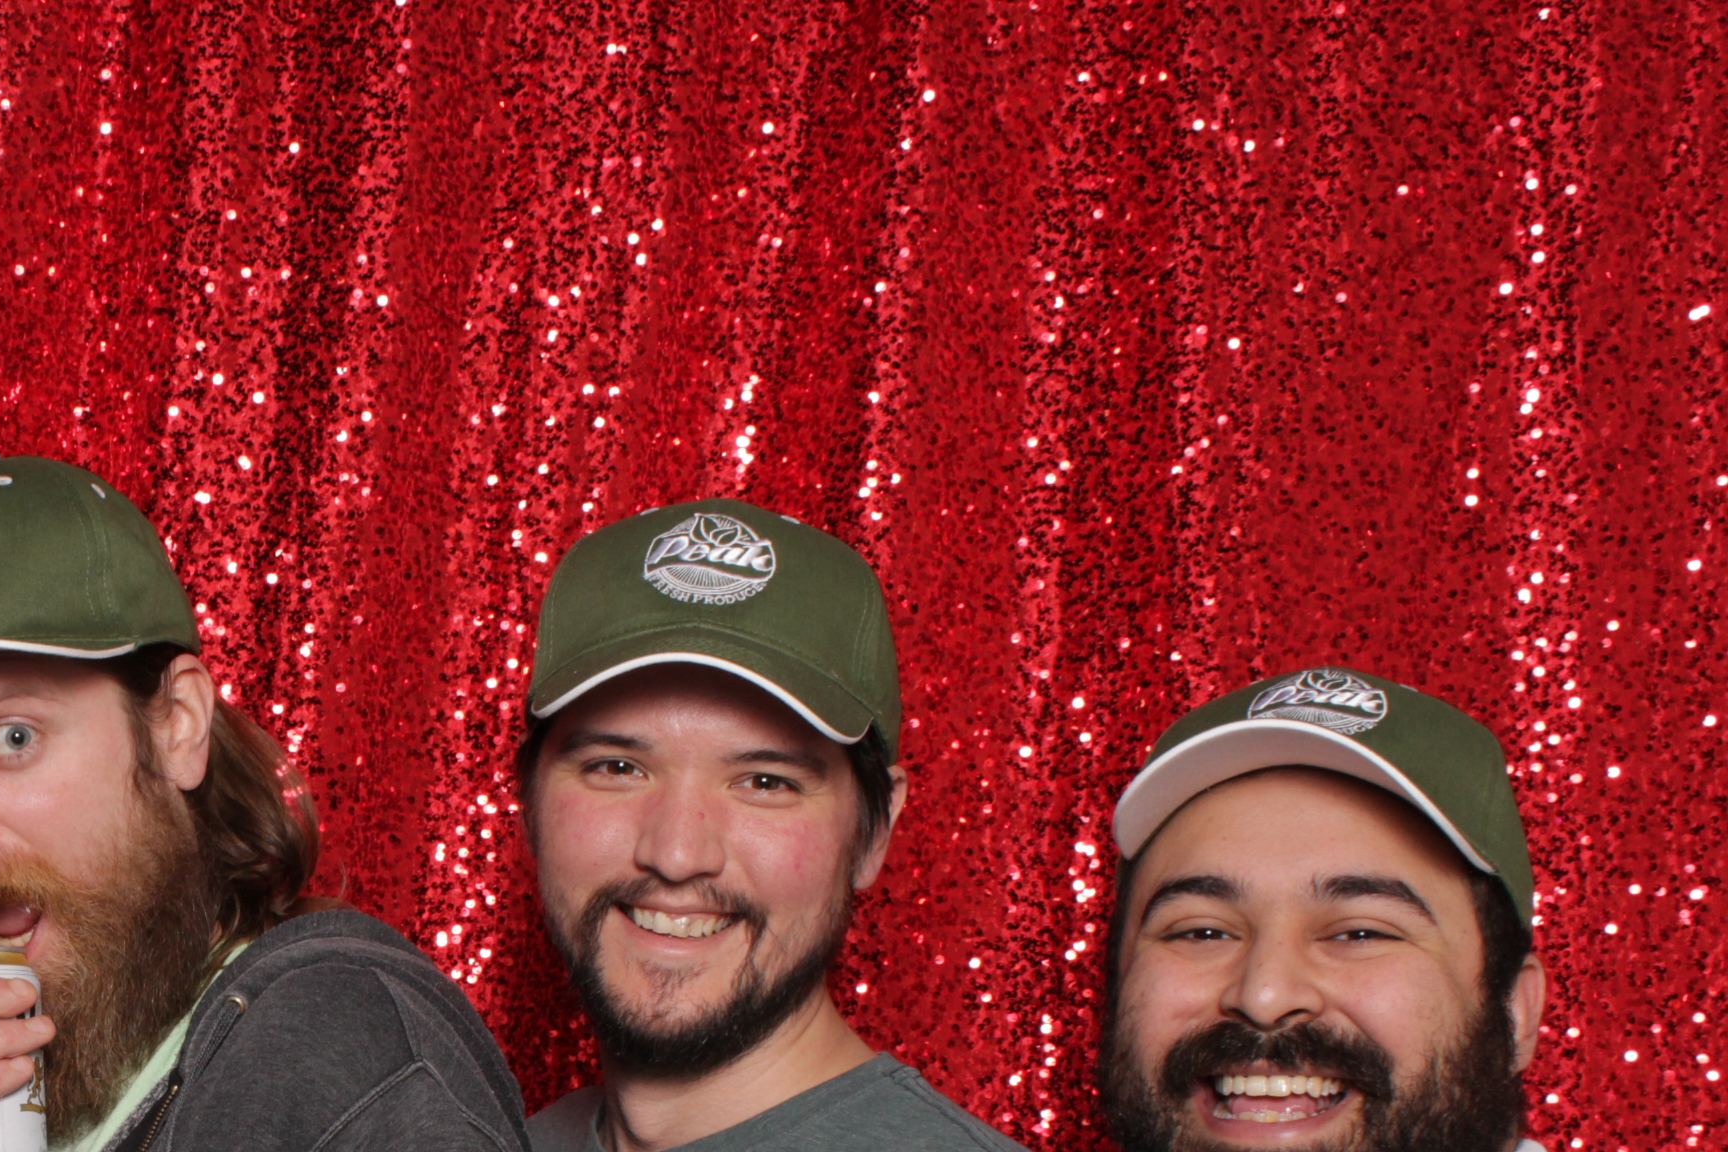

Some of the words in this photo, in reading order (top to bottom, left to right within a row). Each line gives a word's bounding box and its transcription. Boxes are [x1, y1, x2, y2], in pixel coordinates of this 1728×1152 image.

[646, 535, 774, 572] Peak
[647, 576, 690, 603] FRESH
[691, 582, 765, 606] PRODUCE
[1250, 685, 1383, 715] Peak
